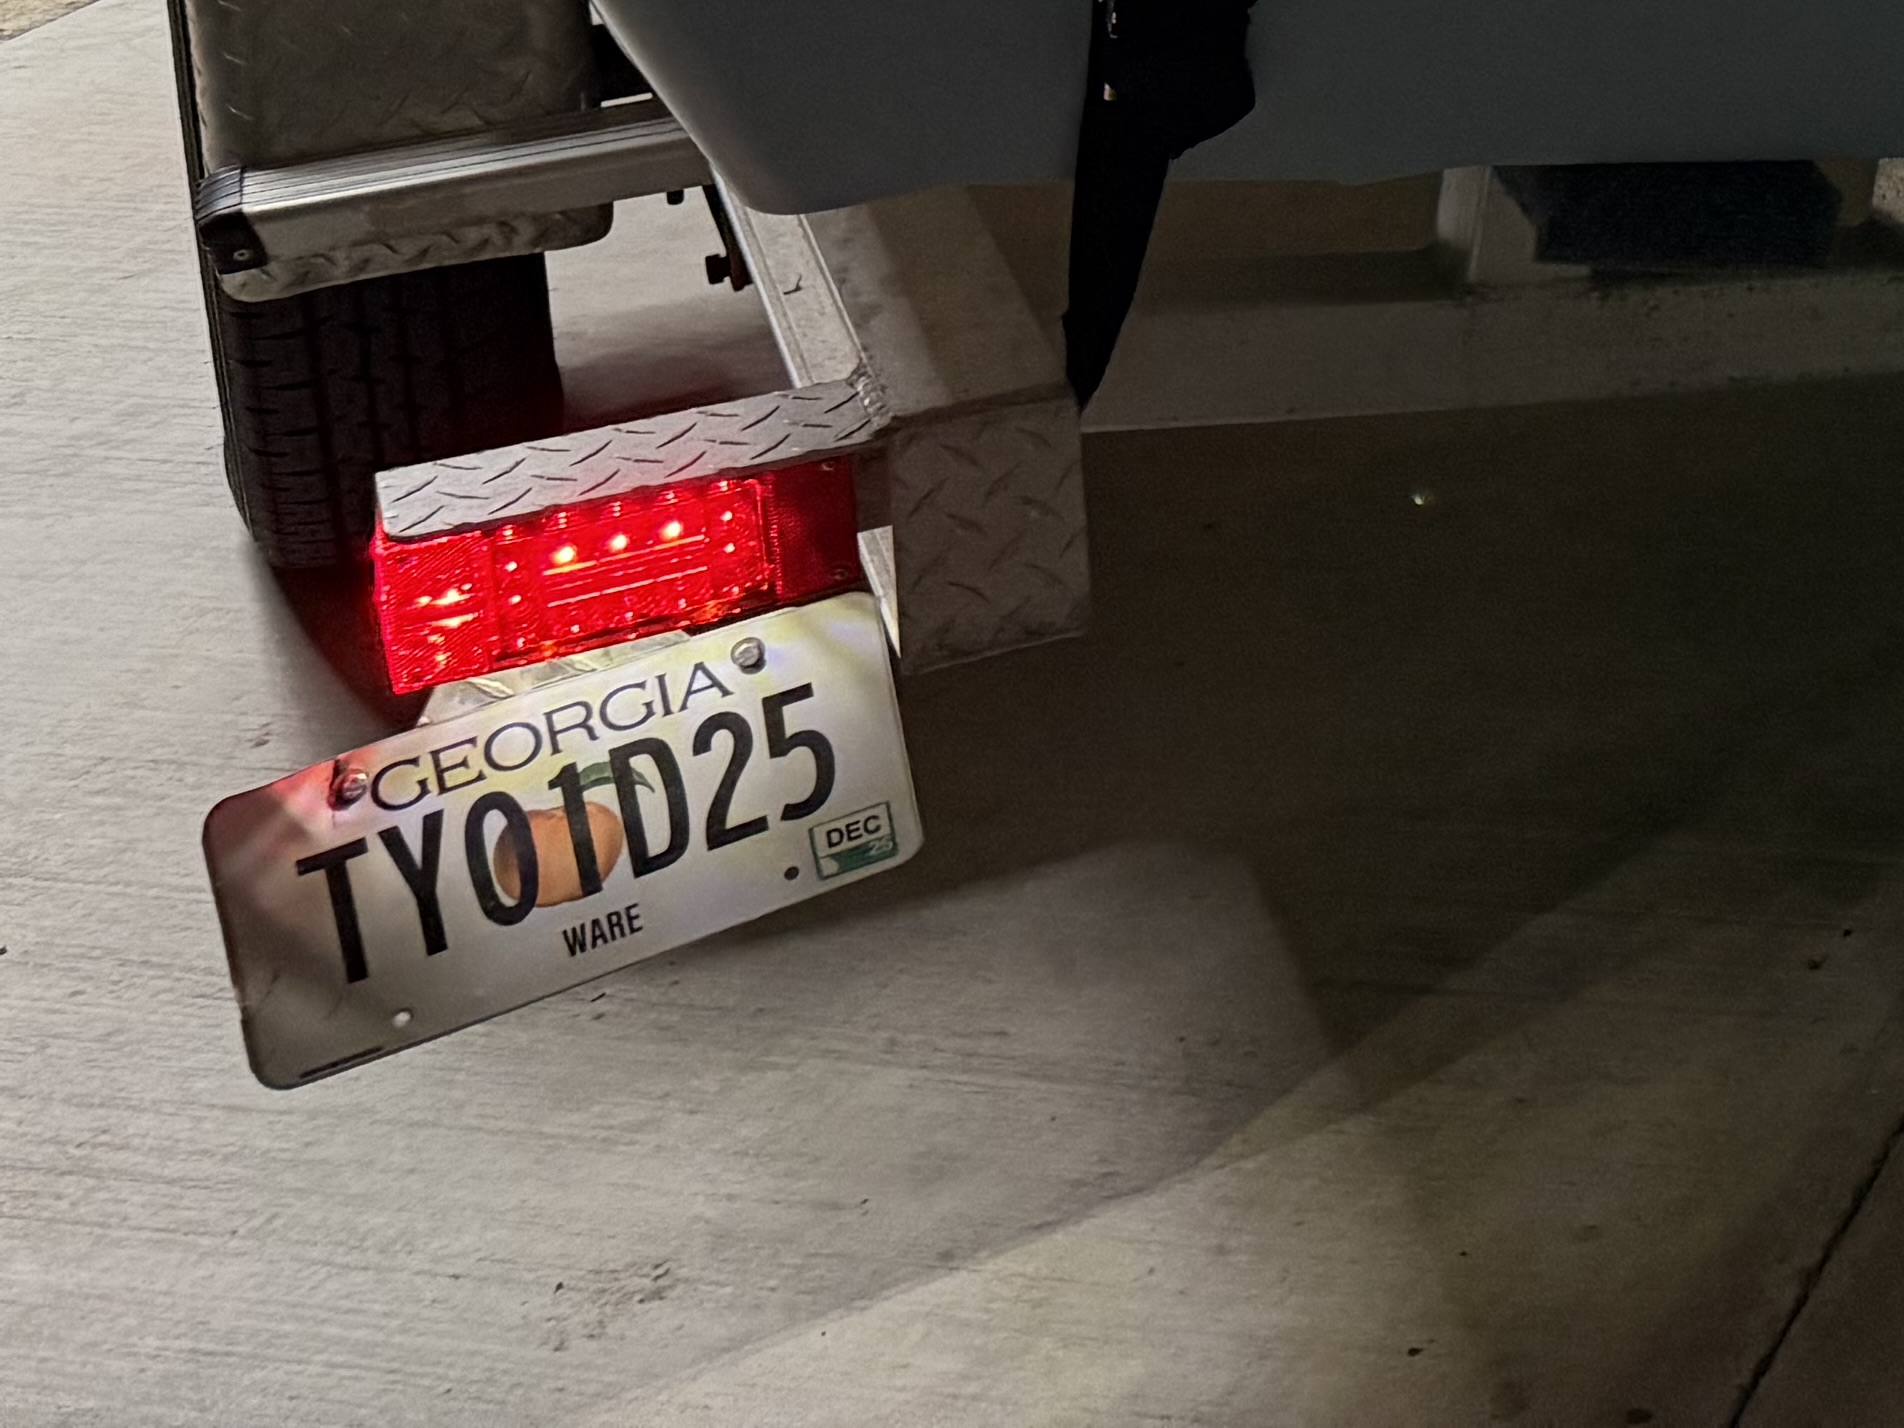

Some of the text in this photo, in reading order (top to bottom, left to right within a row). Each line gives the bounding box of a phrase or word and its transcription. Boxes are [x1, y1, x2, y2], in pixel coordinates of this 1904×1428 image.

[372, 659, 735, 813] GEORGIA
[826, 815, 882, 849] DEC
[561, 902, 645, 958] WARE
